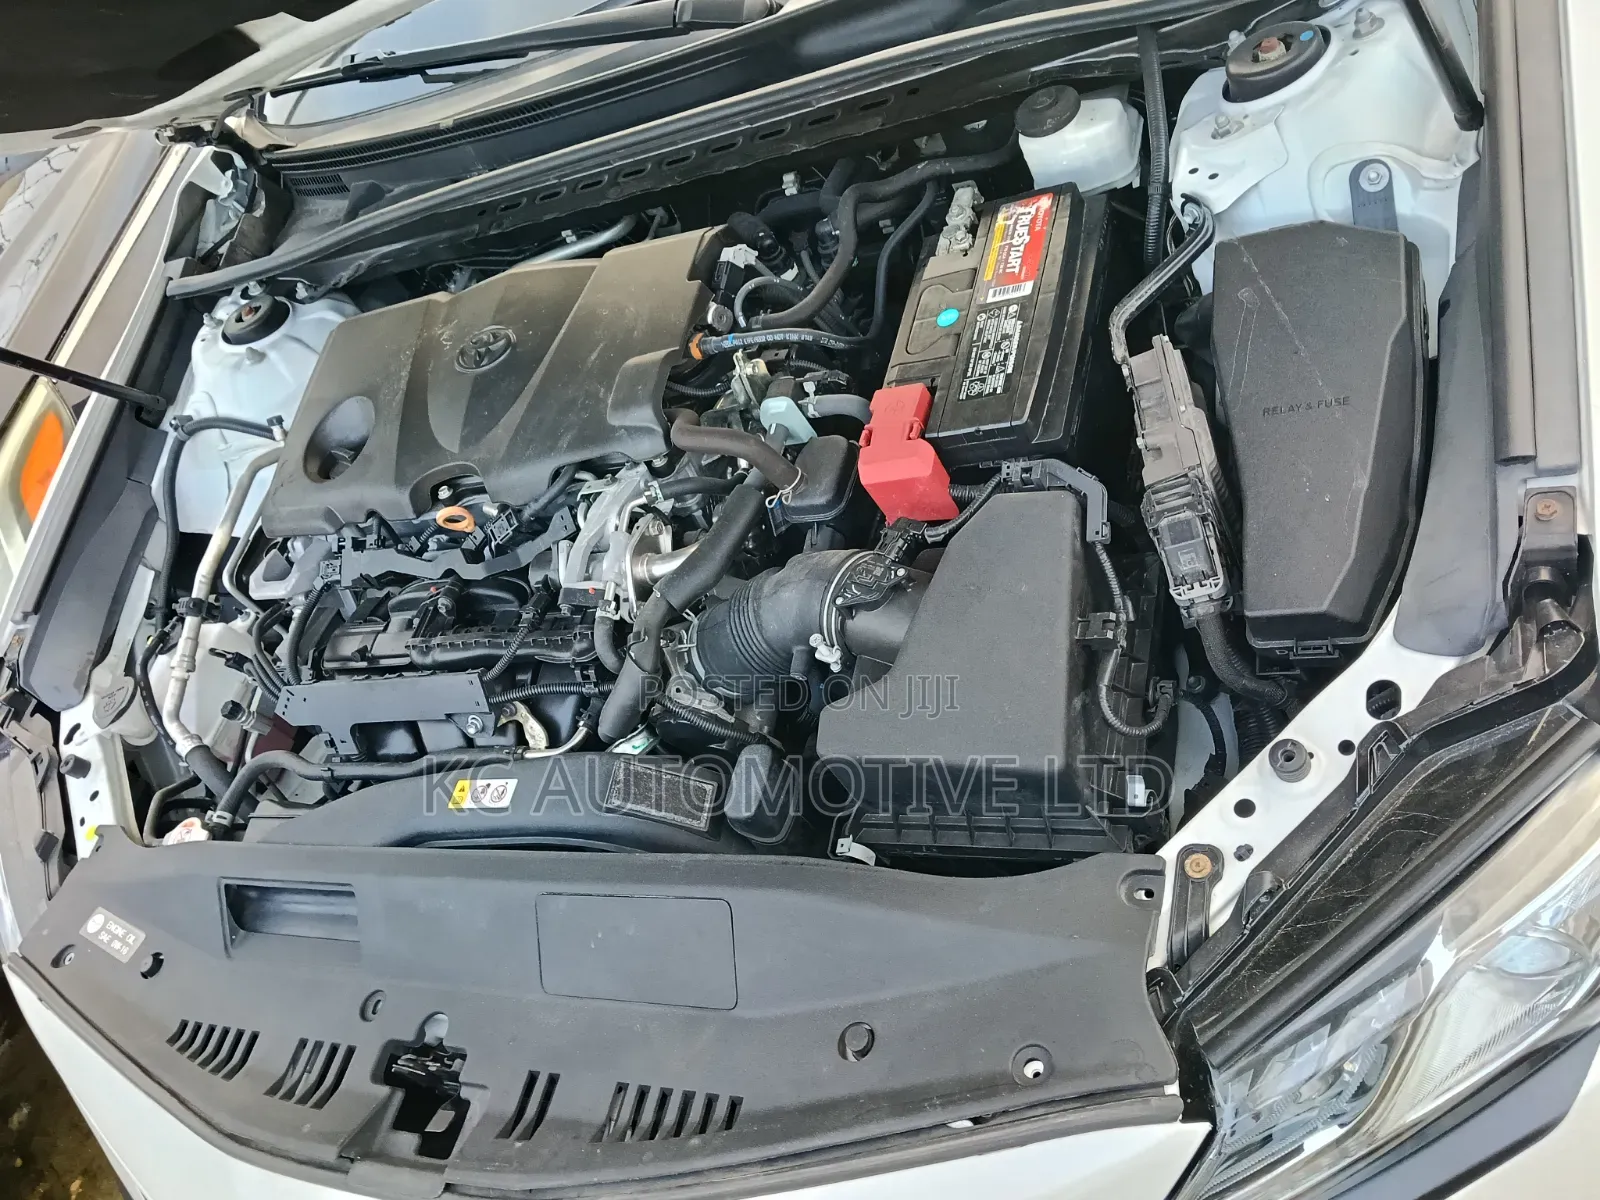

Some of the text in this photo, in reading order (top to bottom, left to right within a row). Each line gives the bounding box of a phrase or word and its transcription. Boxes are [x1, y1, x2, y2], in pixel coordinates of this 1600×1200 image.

[1006, 204, 1037, 274] TRUESTART
[1262, 396, 1350, 417] RELAY & FUSE
[98, 931, 112, 944] SAE
[106, 920, 127, 938] ENGINE
